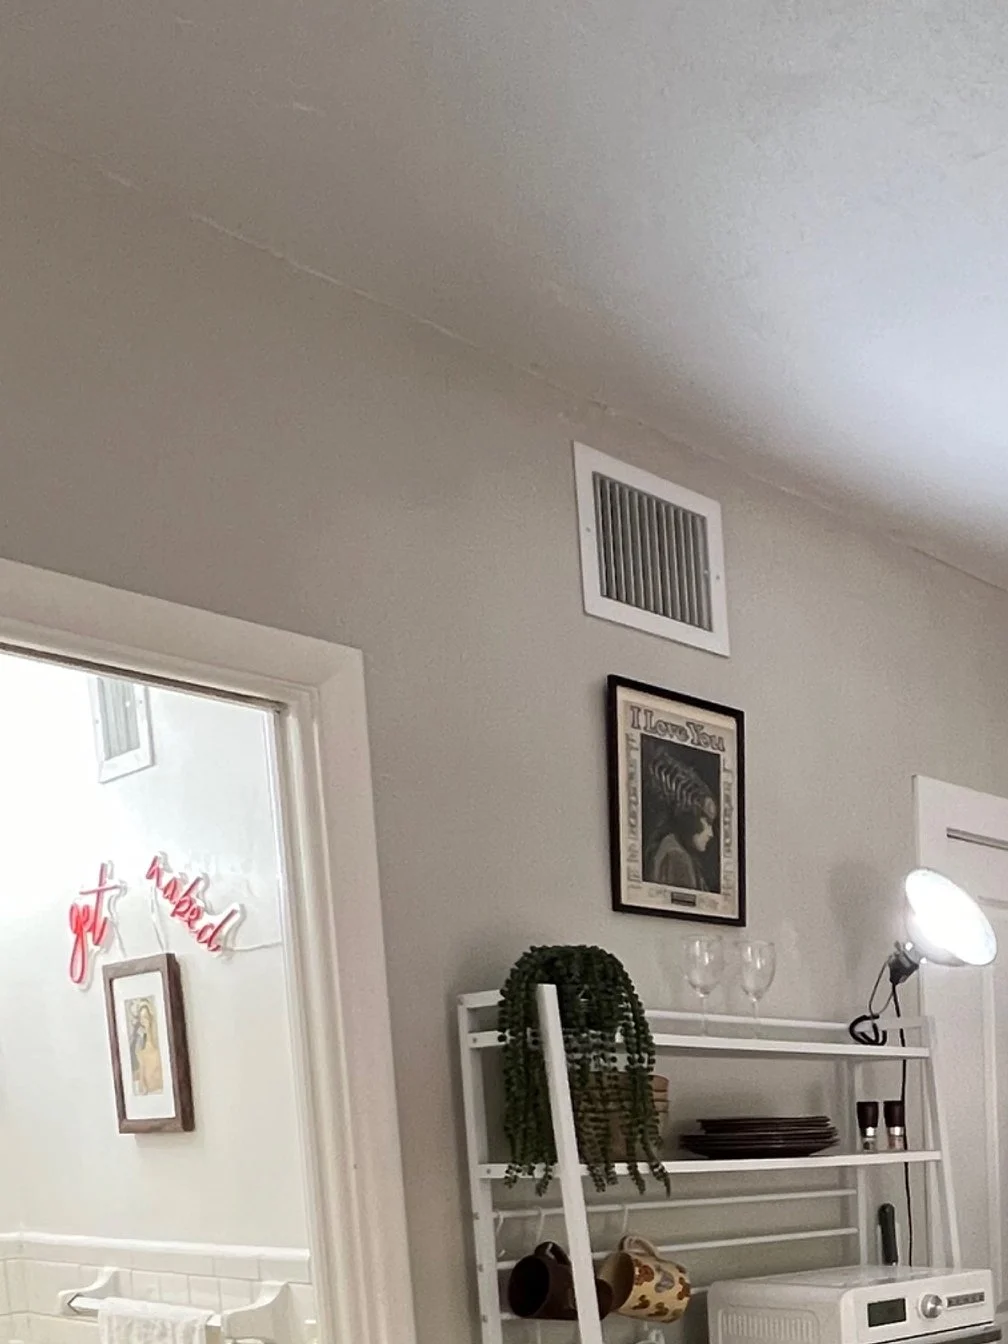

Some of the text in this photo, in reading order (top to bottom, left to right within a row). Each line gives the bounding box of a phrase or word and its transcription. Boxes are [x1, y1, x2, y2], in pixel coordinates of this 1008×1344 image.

[630, 705, 726, 752] I Love You
[69, 862, 121, 984] get
[145, 855, 239, 952] naked
